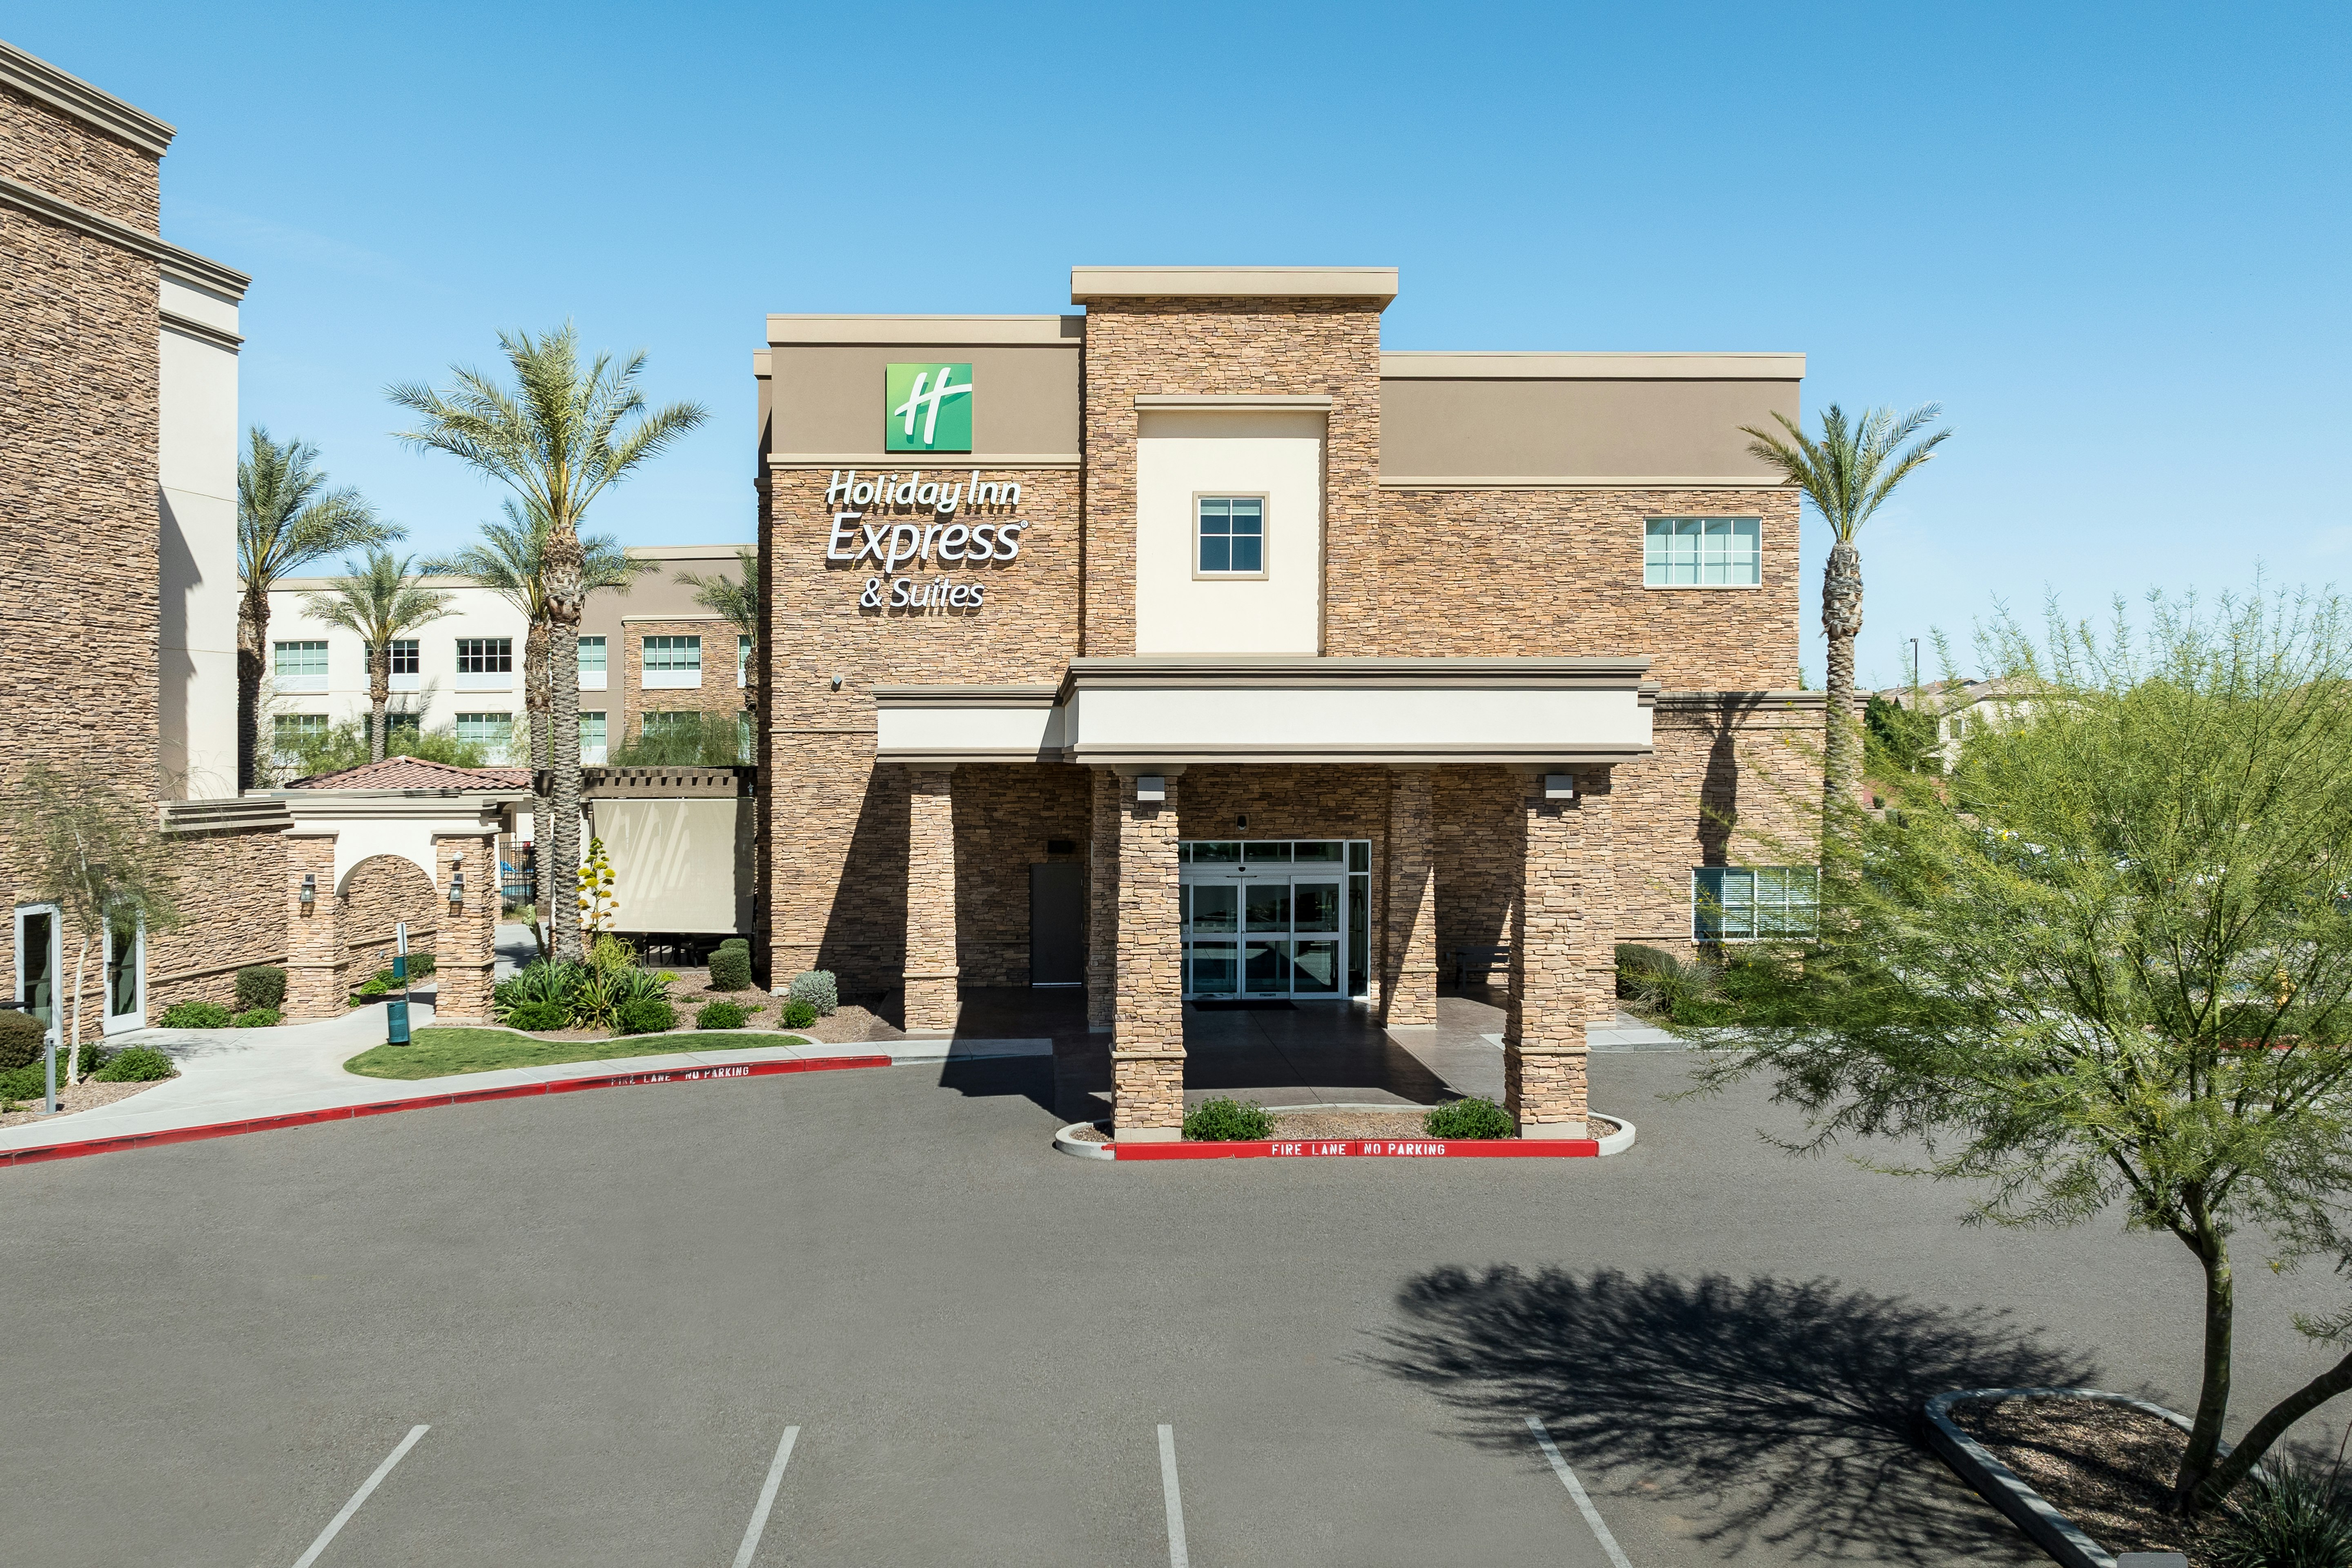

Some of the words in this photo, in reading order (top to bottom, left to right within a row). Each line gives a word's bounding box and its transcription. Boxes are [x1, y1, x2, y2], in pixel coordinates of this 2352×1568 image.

[825, 470, 962, 513] Holiday
[967, 470, 1021, 505] Inn
[860, 577, 883, 607] &
[889, 577, 985, 607] Suites
[643, 1073, 671, 1083] LANE
[685, 1071, 699, 1080] NO
[704, 1067, 749, 1079] PARKING
[1272, 1143, 1302, 1156] FIRE
[1312, 1143, 1346, 1155] LANE
[1364, 1143, 1381, 1155] NO
[1388, 1143, 1445, 1155] PARKING
